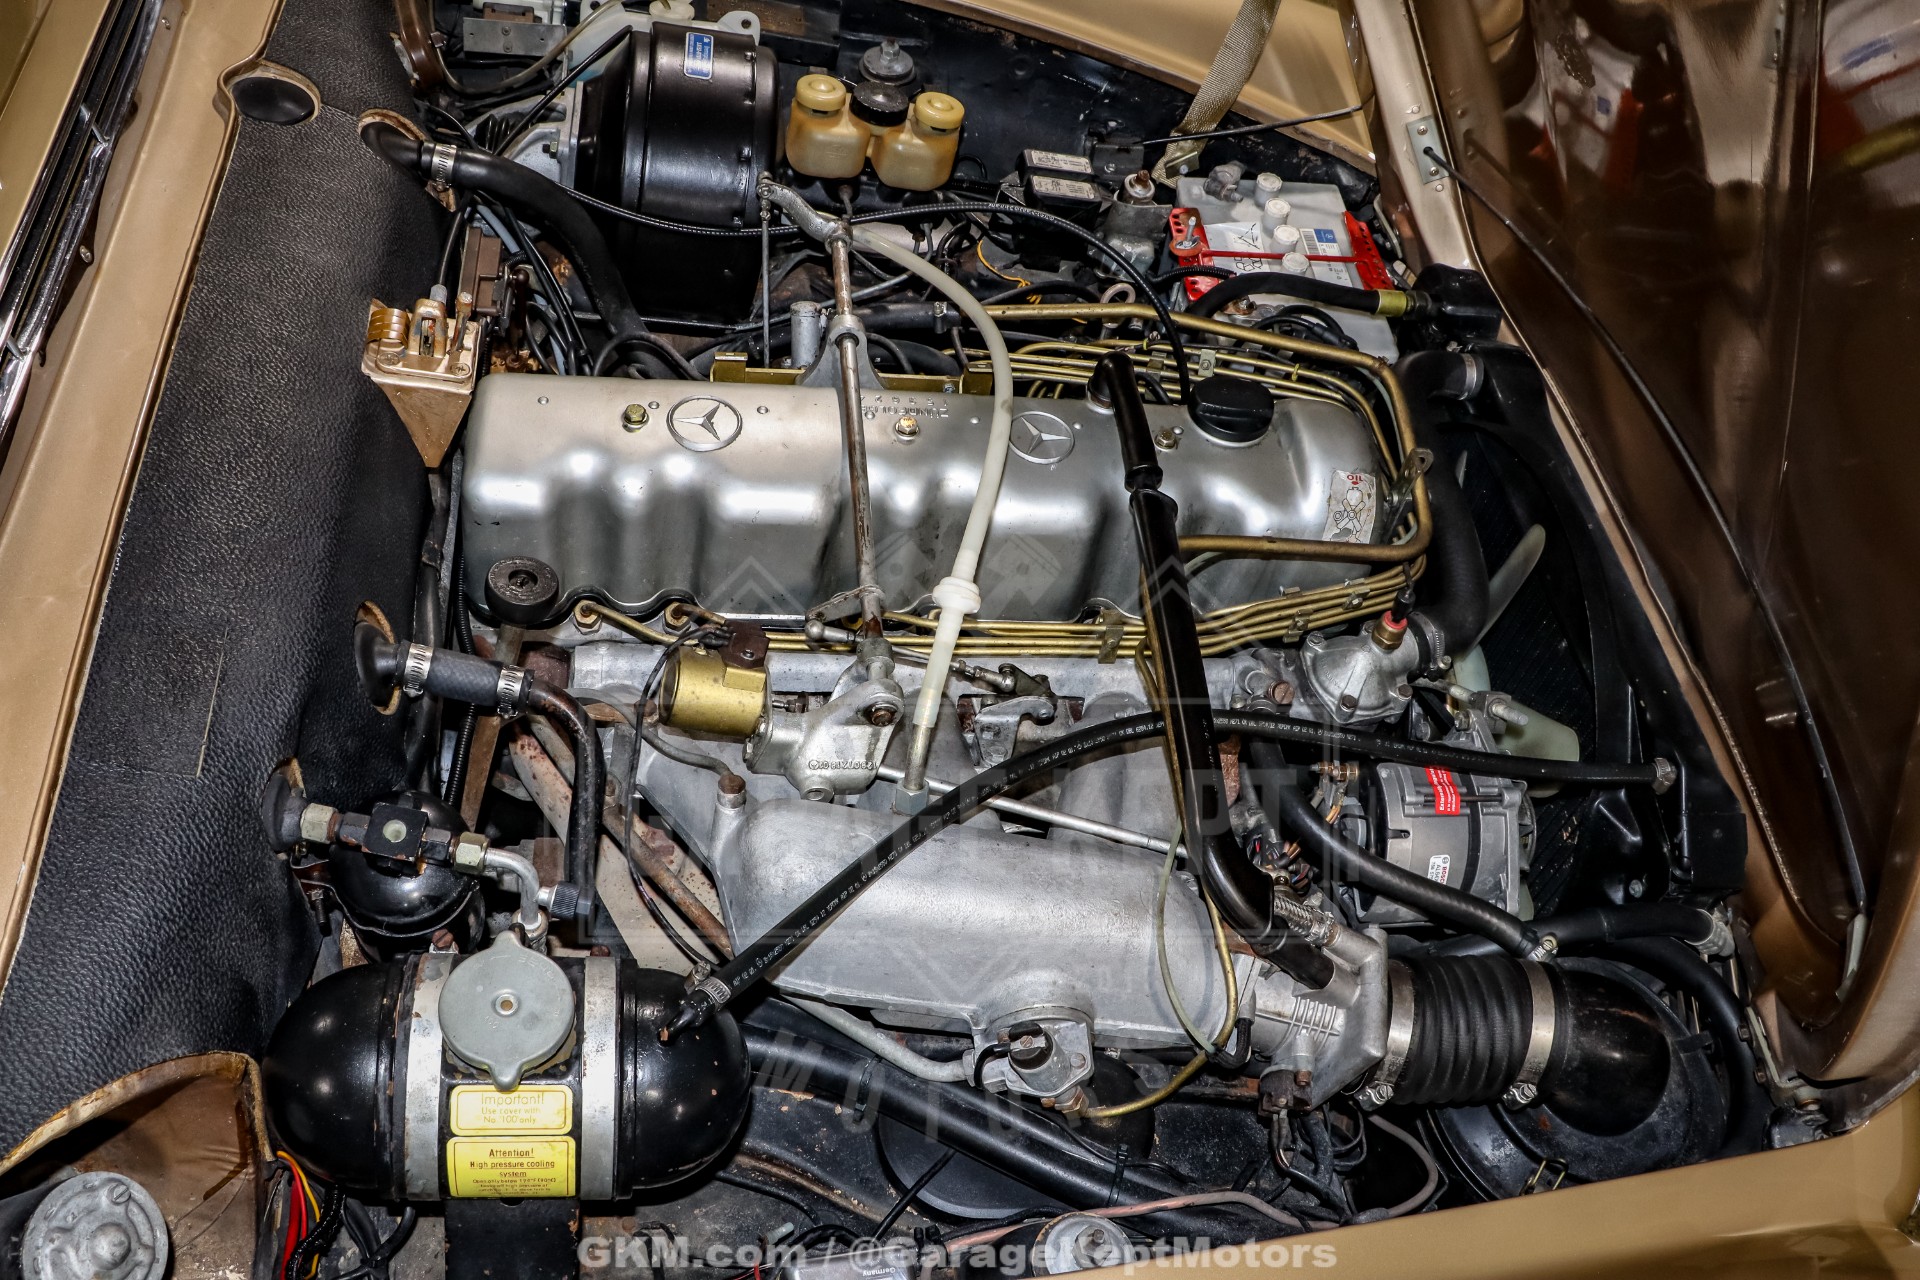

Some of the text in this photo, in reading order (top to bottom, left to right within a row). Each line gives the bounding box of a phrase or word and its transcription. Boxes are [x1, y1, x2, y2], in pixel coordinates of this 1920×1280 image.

[482, 1092, 544, 1106] Important!
[520, 1115, 536, 1124] only
[489, 1148, 534, 1157] Attention!
[863, 1267, 895, 1276] Germany
